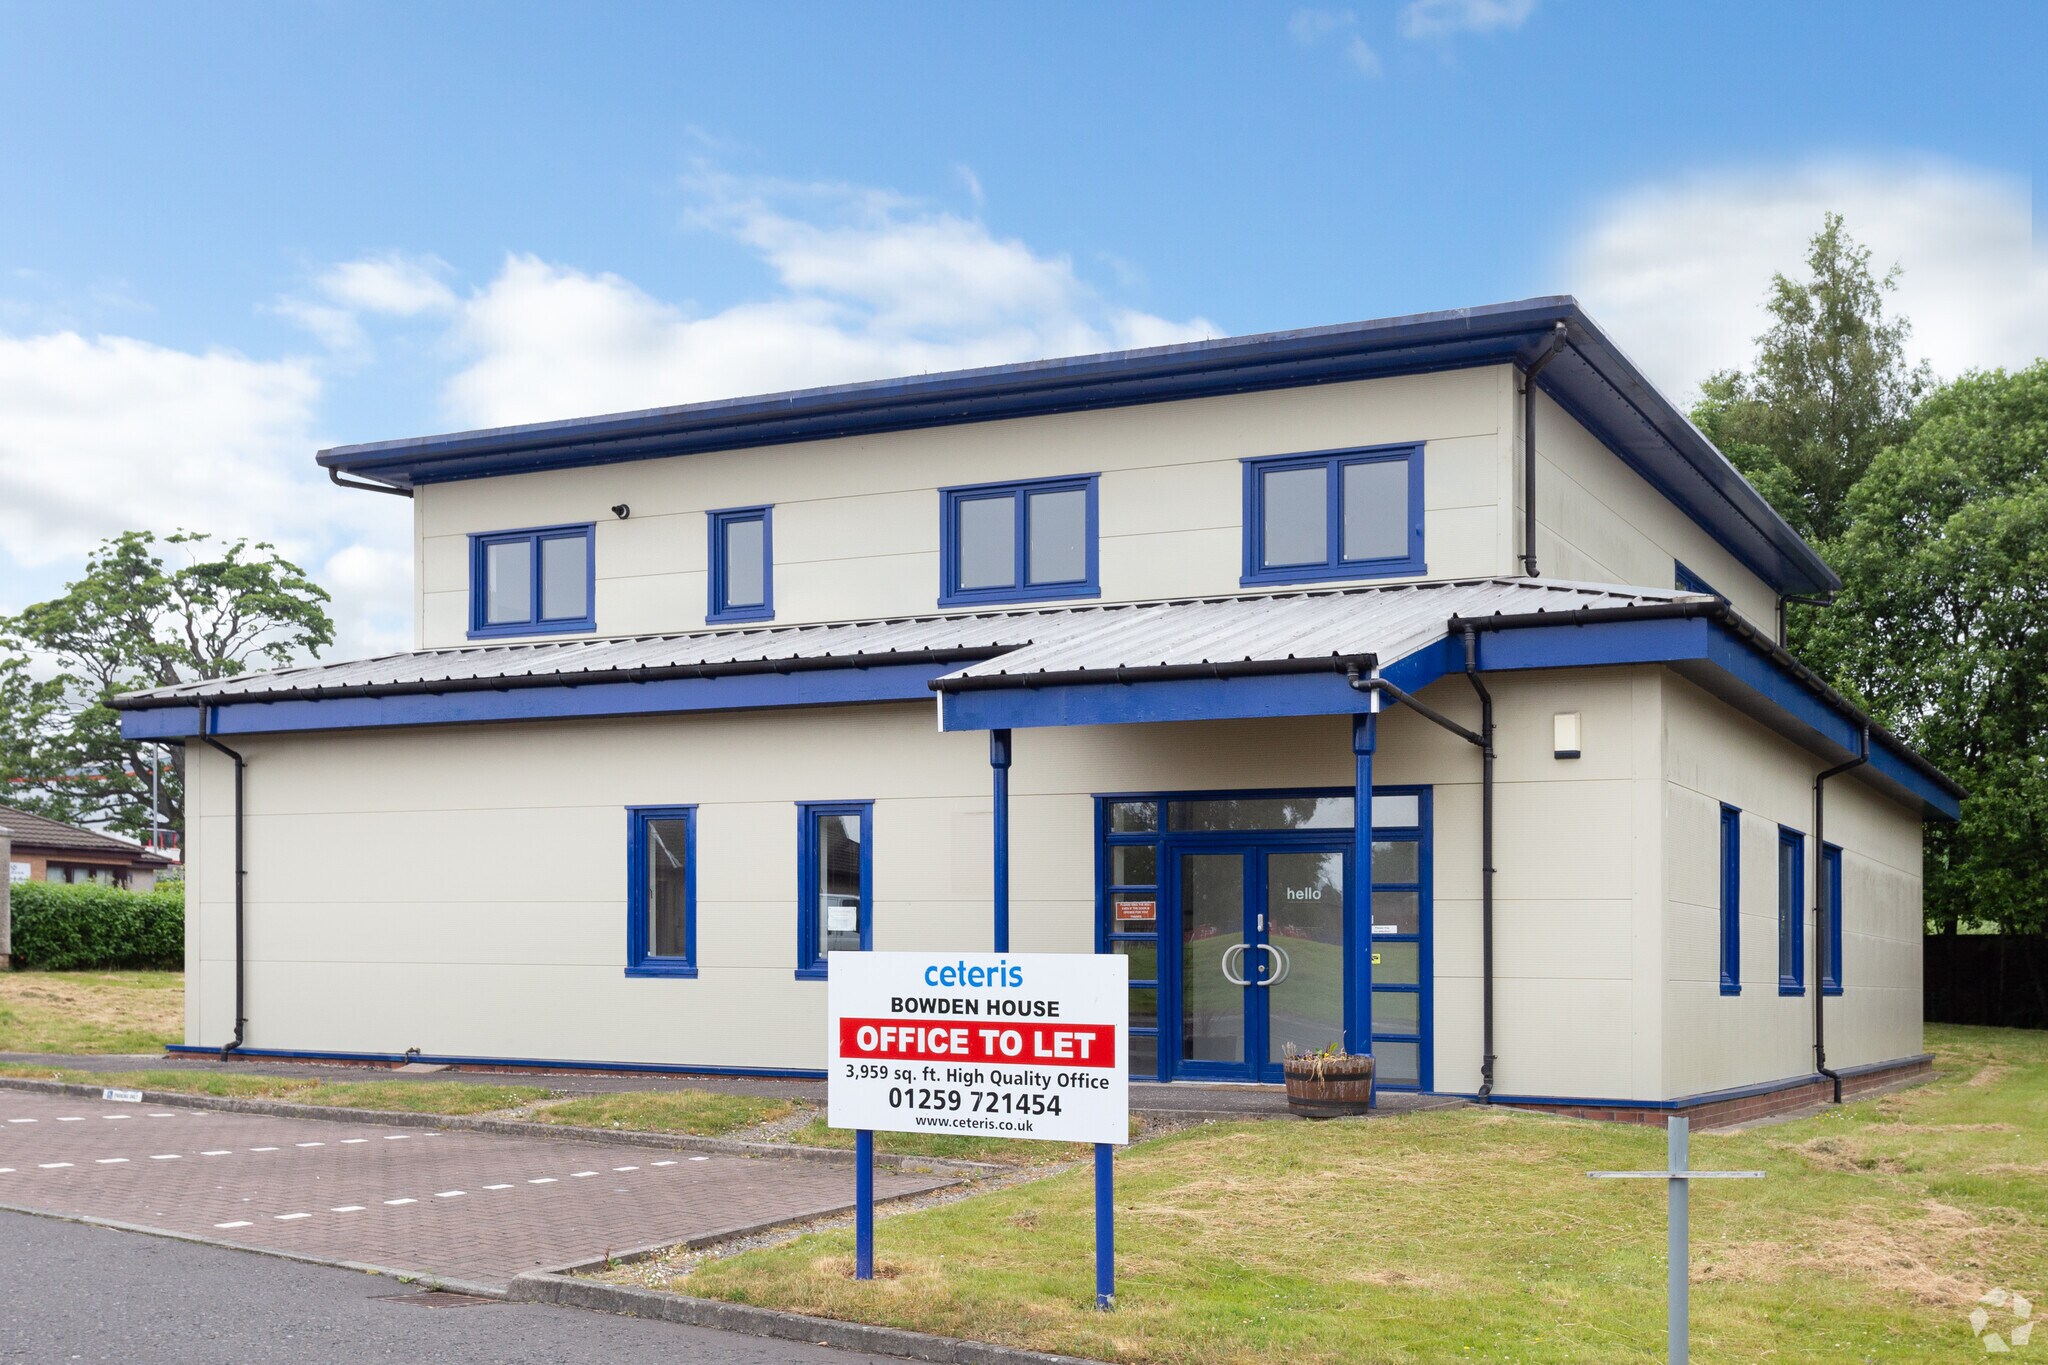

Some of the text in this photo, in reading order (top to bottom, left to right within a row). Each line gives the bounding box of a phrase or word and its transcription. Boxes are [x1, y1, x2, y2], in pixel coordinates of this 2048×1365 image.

[1287, 887, 1321, 900] hello
[924, 959, 1024, 988] ceteris
[891, 997, 1060, 1017] BOWDEN HOUSE
[856, 1025, 1096, 1059] OFFICE TO LET
[846, 1064, 1110, 1090] 3,959 sq. ft. High Quality Office
[888, 1087, 1062, 1116] 01259 721454
[916, 1115, 1033, 1132] www.ceteris.co.uk
